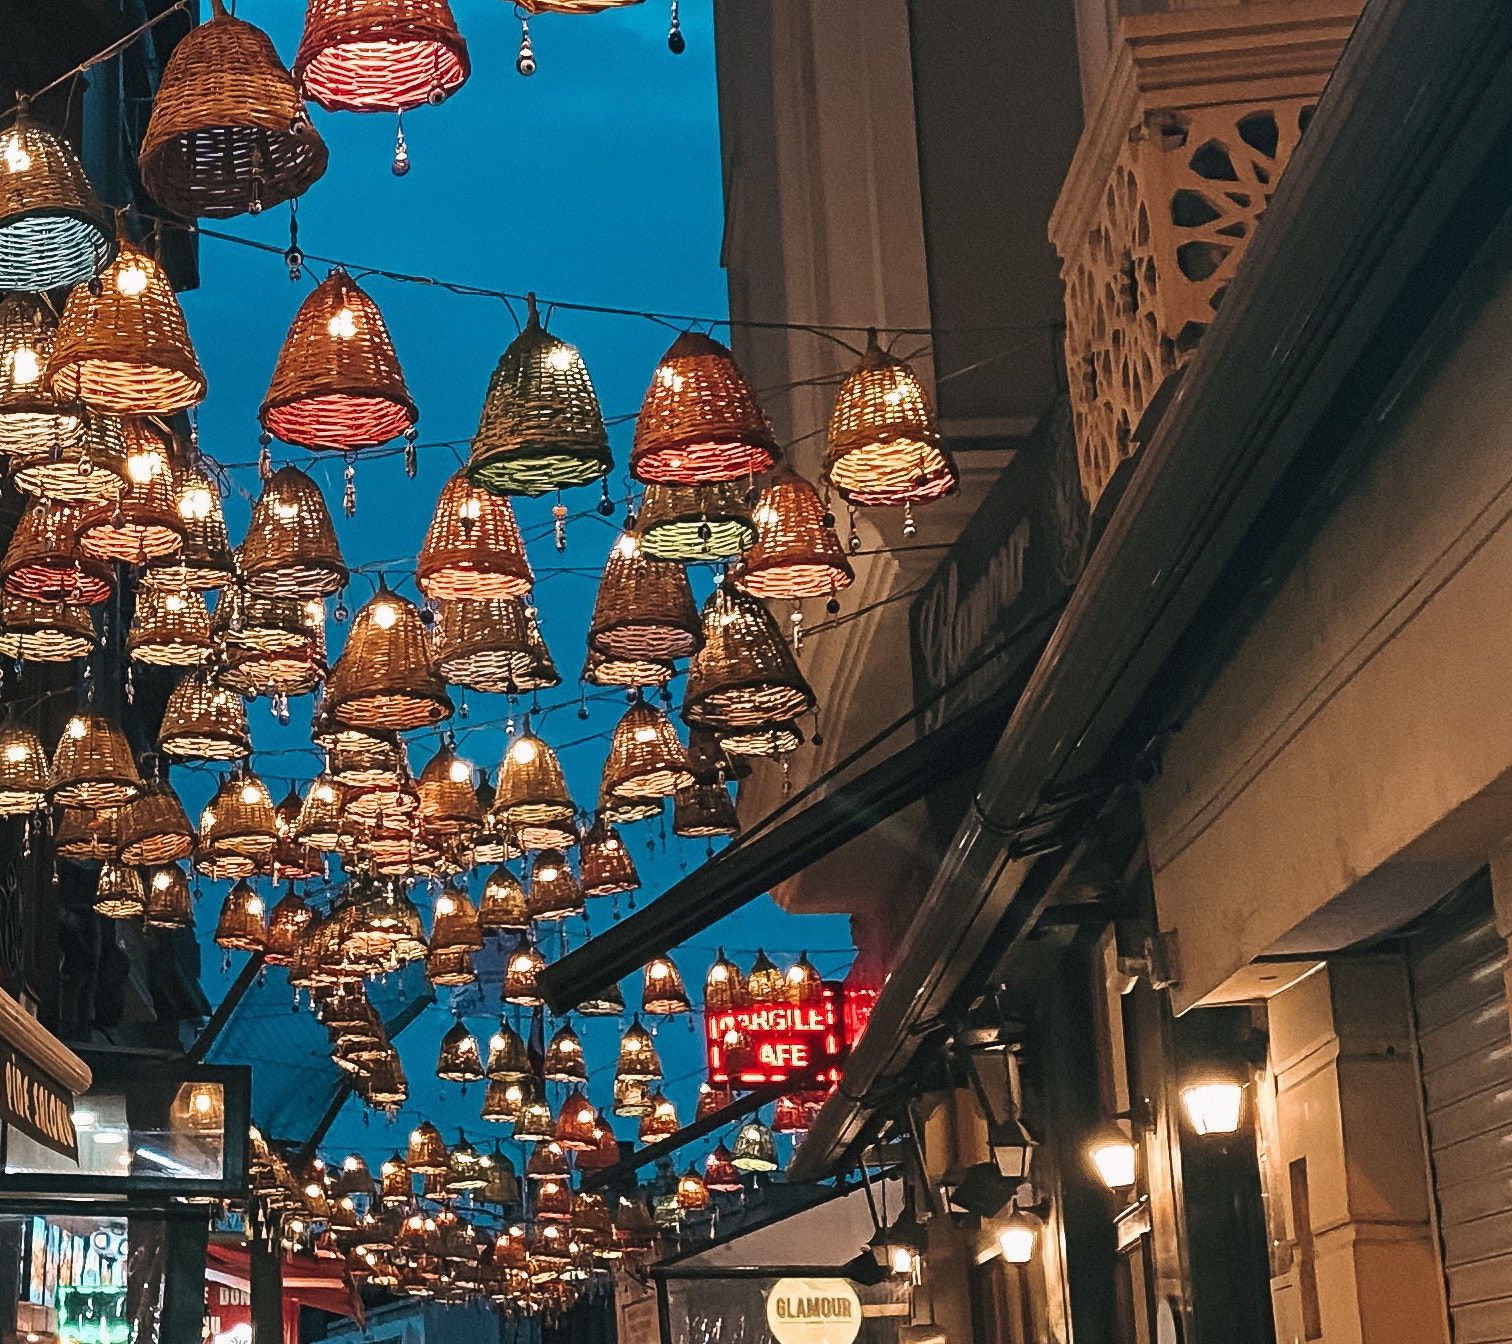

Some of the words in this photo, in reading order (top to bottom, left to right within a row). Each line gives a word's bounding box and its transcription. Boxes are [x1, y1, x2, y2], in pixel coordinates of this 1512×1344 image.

[760, 1043, 809, 1067] AFE
[5, 1053, 32, 1123] PİDE
[33, 1082, 74, 1147] SALONU
[776, 1297, 852, 1318] GLAMOUR
